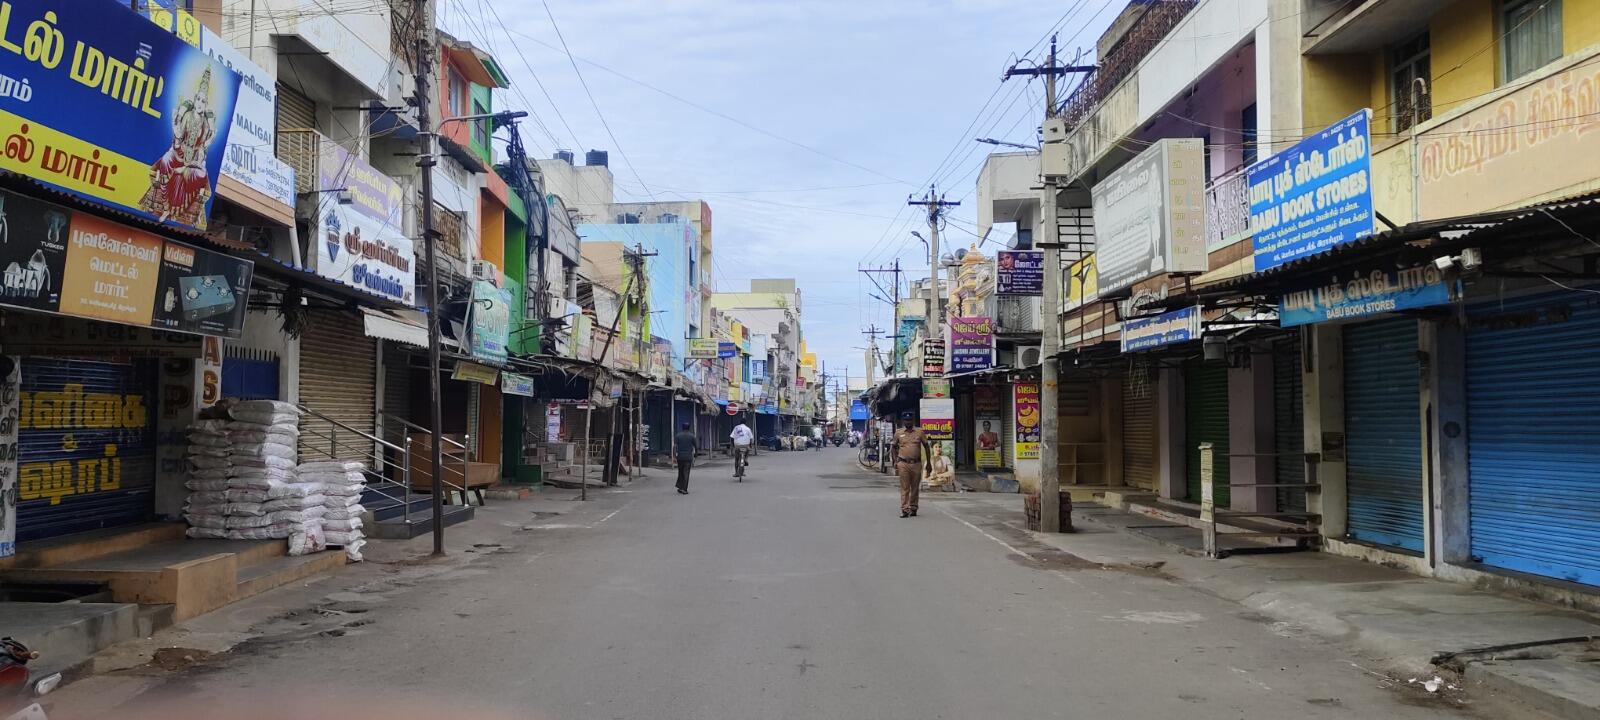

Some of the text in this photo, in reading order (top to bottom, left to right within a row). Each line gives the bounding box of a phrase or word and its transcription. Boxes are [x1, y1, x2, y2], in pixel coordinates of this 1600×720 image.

[70, 40, 165, 119] மார்ட்
[236, 113, 272, 146] MALIGAI
[41, 146, 118, 192] மார்ட்
[1250, 176, 1274, 206] பாபு
[1274, 159, 1294, 199] புக்
[1251, 204, 1280, 235] BABU
[1282, 190, 1315, 224] BOOK
[1316, 169, 1368, 209] STORES
[72, 229, 159, 264] புவனேஸ்வரி
[89, 256, 139, 280] மெட்டல்
[94, 280, 129, 299] மார்ட்
[1283, 288, 1315, 312] பாபு
[1317, 276, 1344, 308] புக்
[1326, 299, 1396, 319] BABU BOOK STORES
